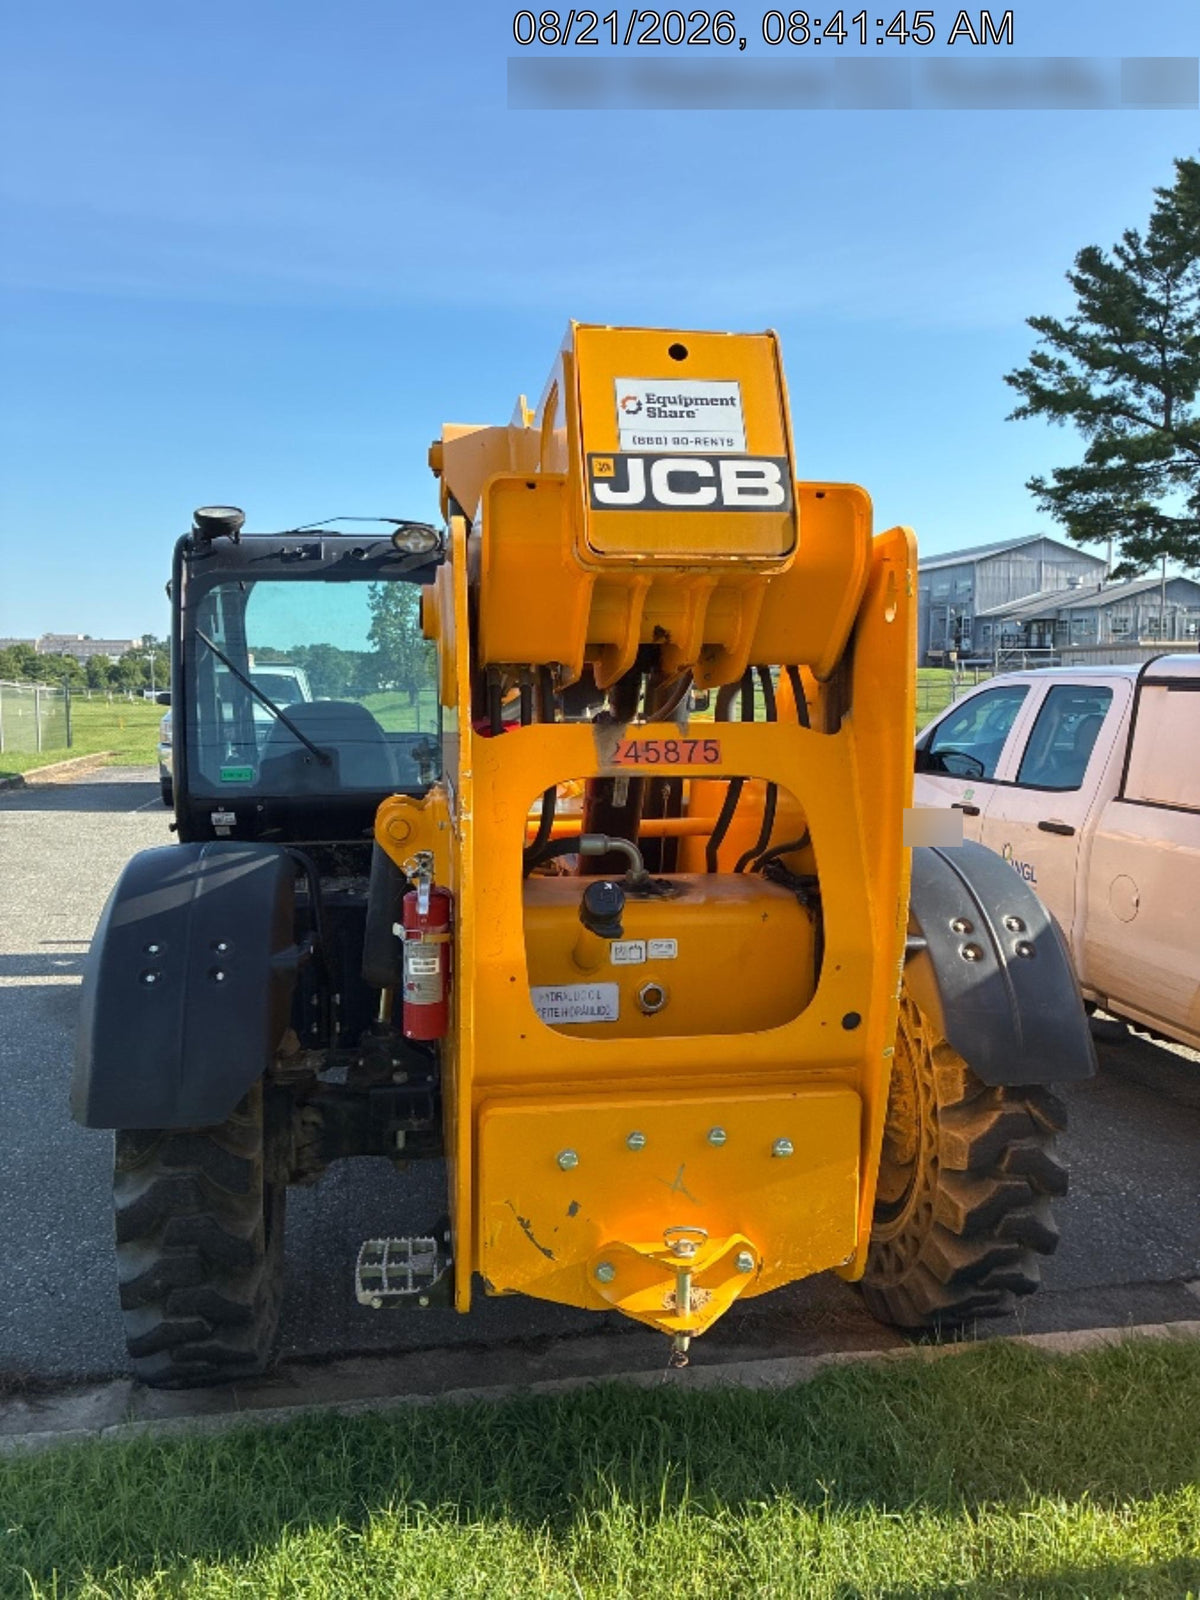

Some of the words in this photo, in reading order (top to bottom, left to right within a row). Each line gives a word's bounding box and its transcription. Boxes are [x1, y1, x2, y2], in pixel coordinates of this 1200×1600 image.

[645, 393, 737, 407] Equipment
[646, 407, 696, 419] Share
[593, 458, 785, 506] JCB
